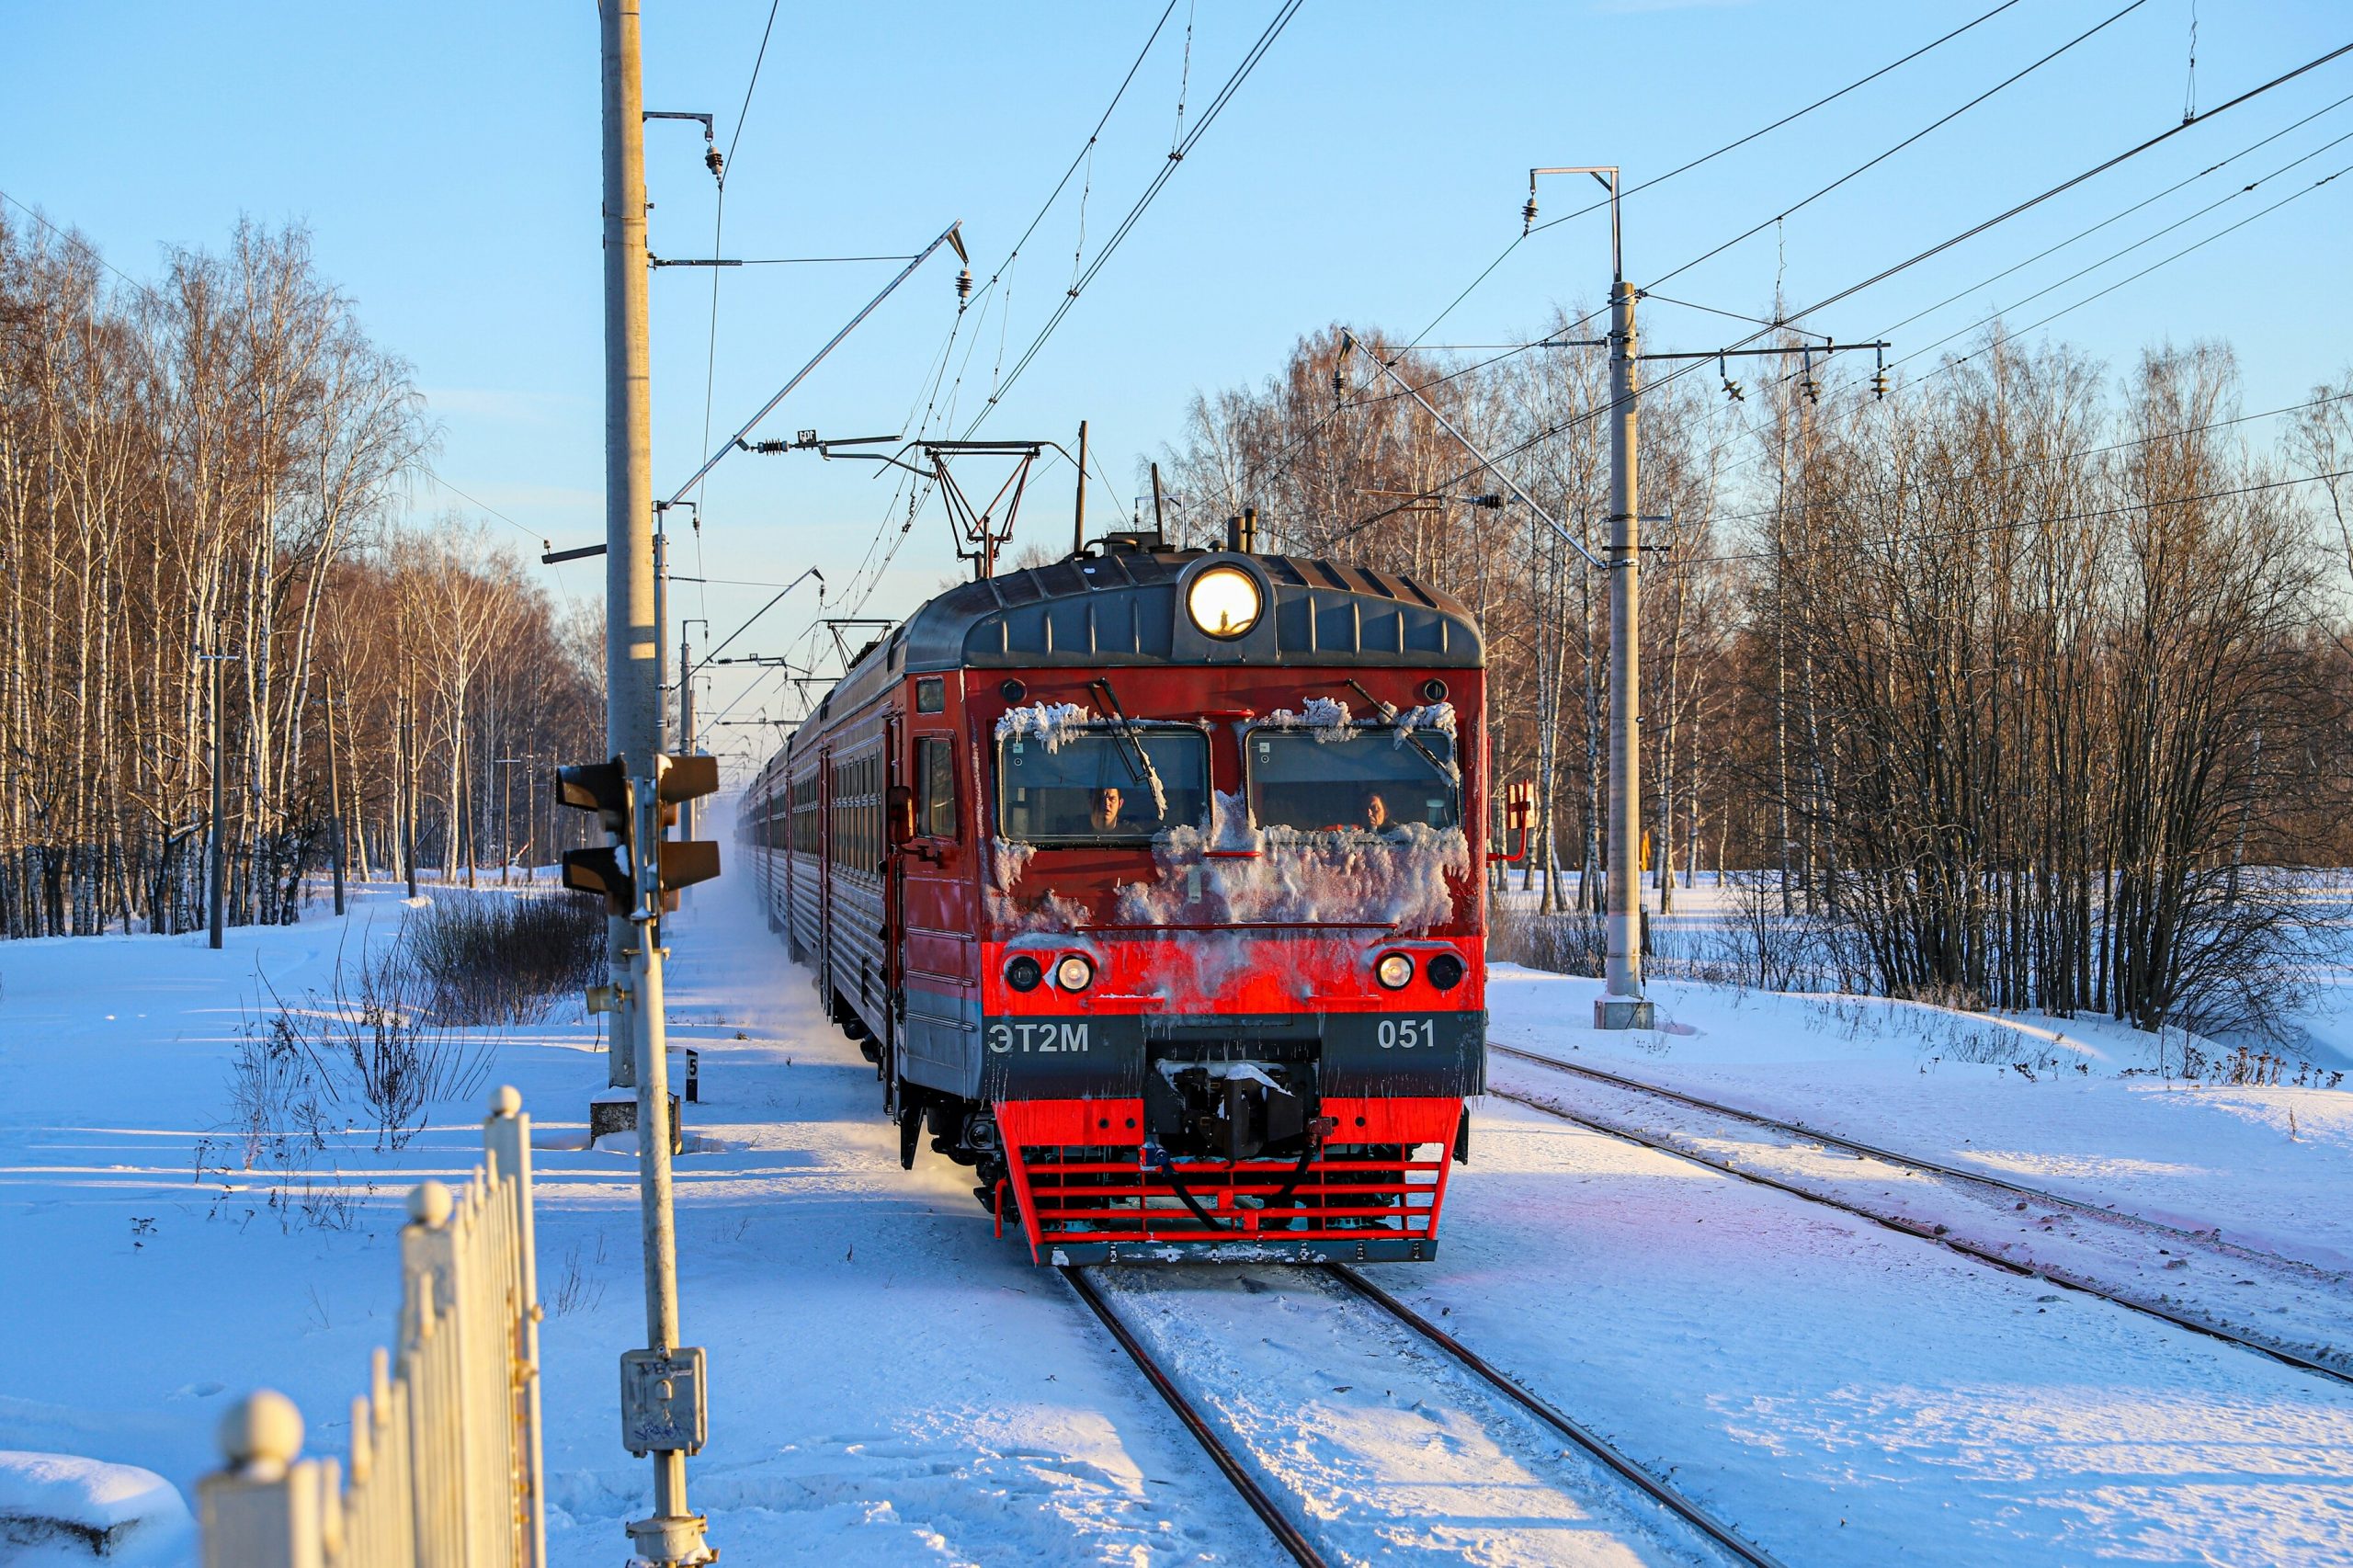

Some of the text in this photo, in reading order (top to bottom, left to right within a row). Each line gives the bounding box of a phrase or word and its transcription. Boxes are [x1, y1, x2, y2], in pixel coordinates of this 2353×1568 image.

[988, 1023, 1089, 1053] ЭТ2М
[1377, 1018, 1435, 1049] 051
[689, 1058, 697, 1076] 5
